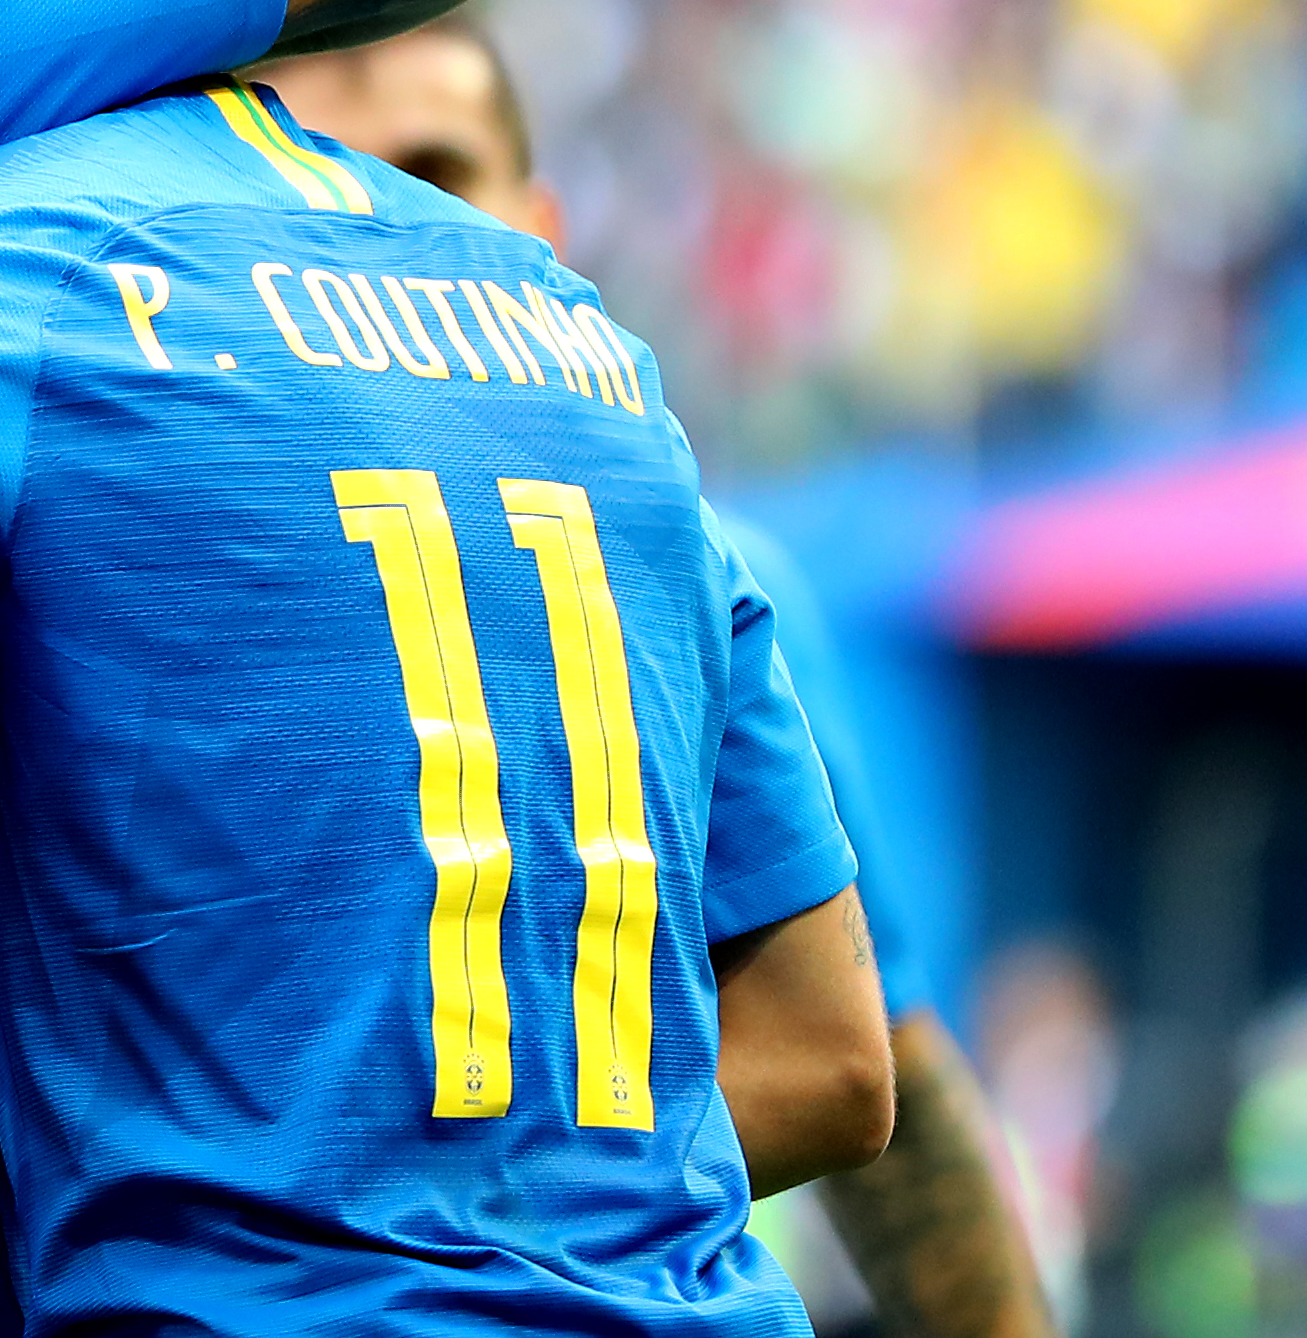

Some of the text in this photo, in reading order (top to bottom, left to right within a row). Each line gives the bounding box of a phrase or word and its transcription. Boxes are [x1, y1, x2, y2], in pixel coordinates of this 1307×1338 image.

[108, 262, 645, 416] P. COUTINHO
[330, 469, 656, 1132] 11
